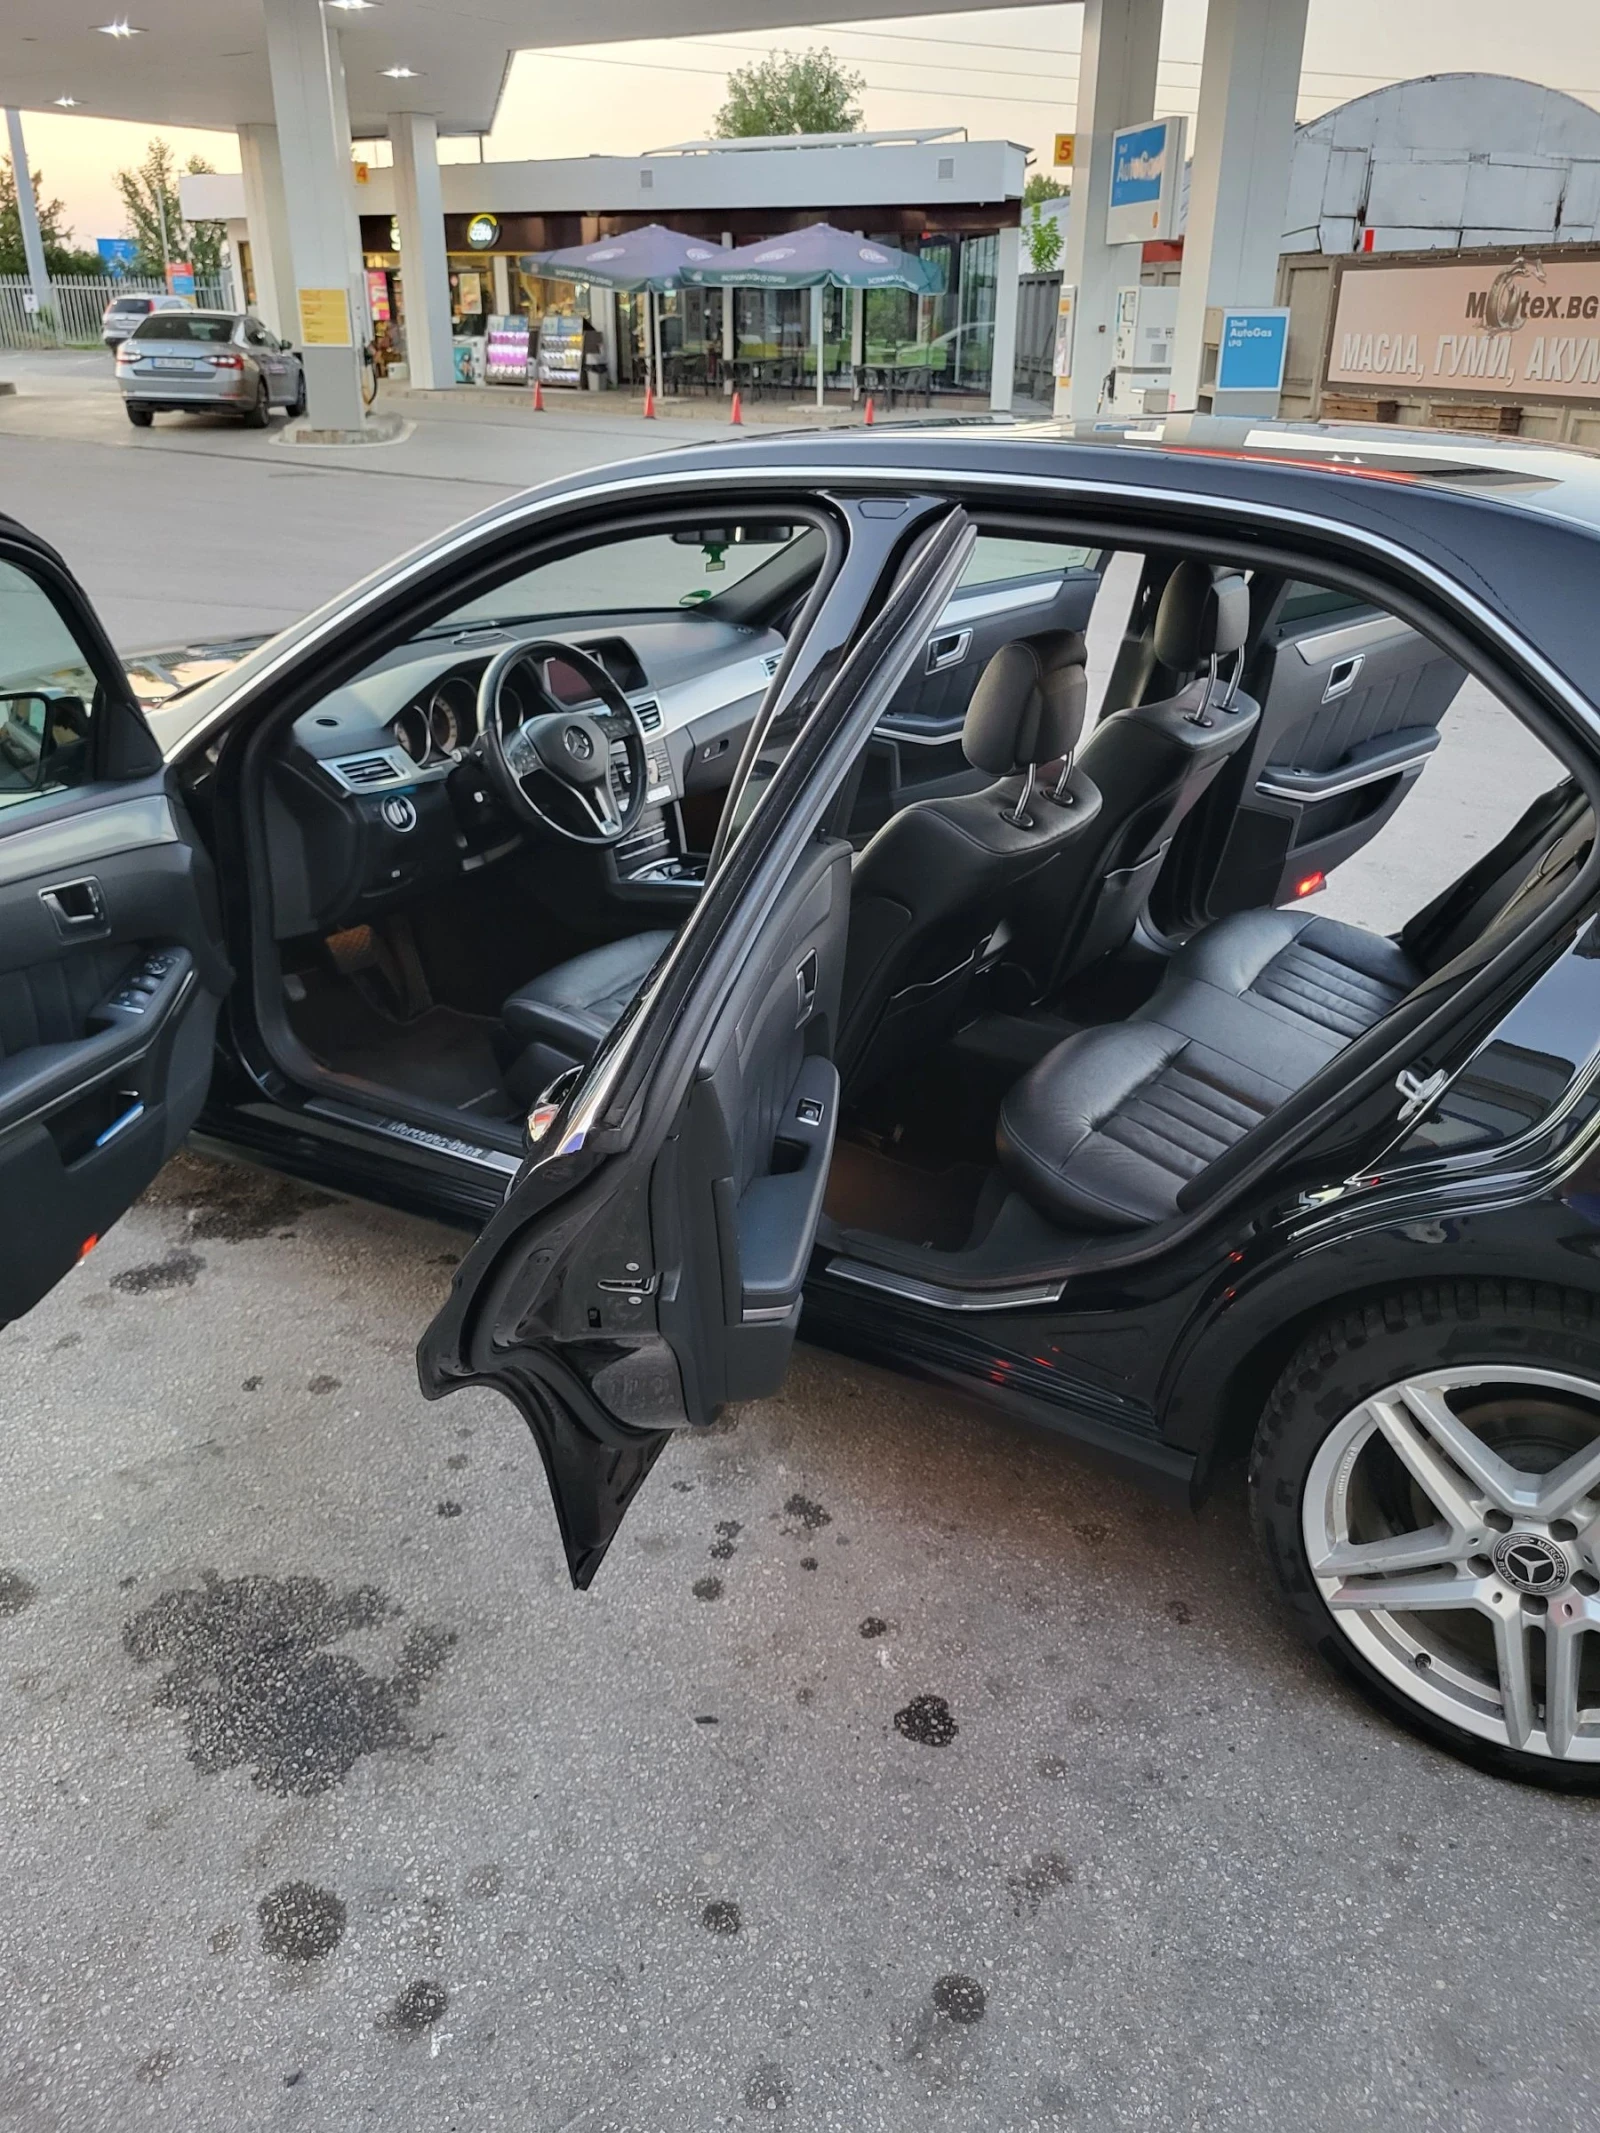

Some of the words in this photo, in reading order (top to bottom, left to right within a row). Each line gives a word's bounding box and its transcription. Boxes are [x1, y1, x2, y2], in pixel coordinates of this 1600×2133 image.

[1058, 140, 1071, 161] 5
[356, 166, 368, 183] 4
[1230, 327, 1272, 337] AutoGas
[1339, 333, 1425, 382] МАСЛА,
[1433, 335, 1516, 387] ГУМИ,
[387, 1120, 483, 1158] Mercedes-Benz
[1536, 1540, 1565, 1578] MERCEDES
[1497, 1561, 1516, 1582] BENZ
